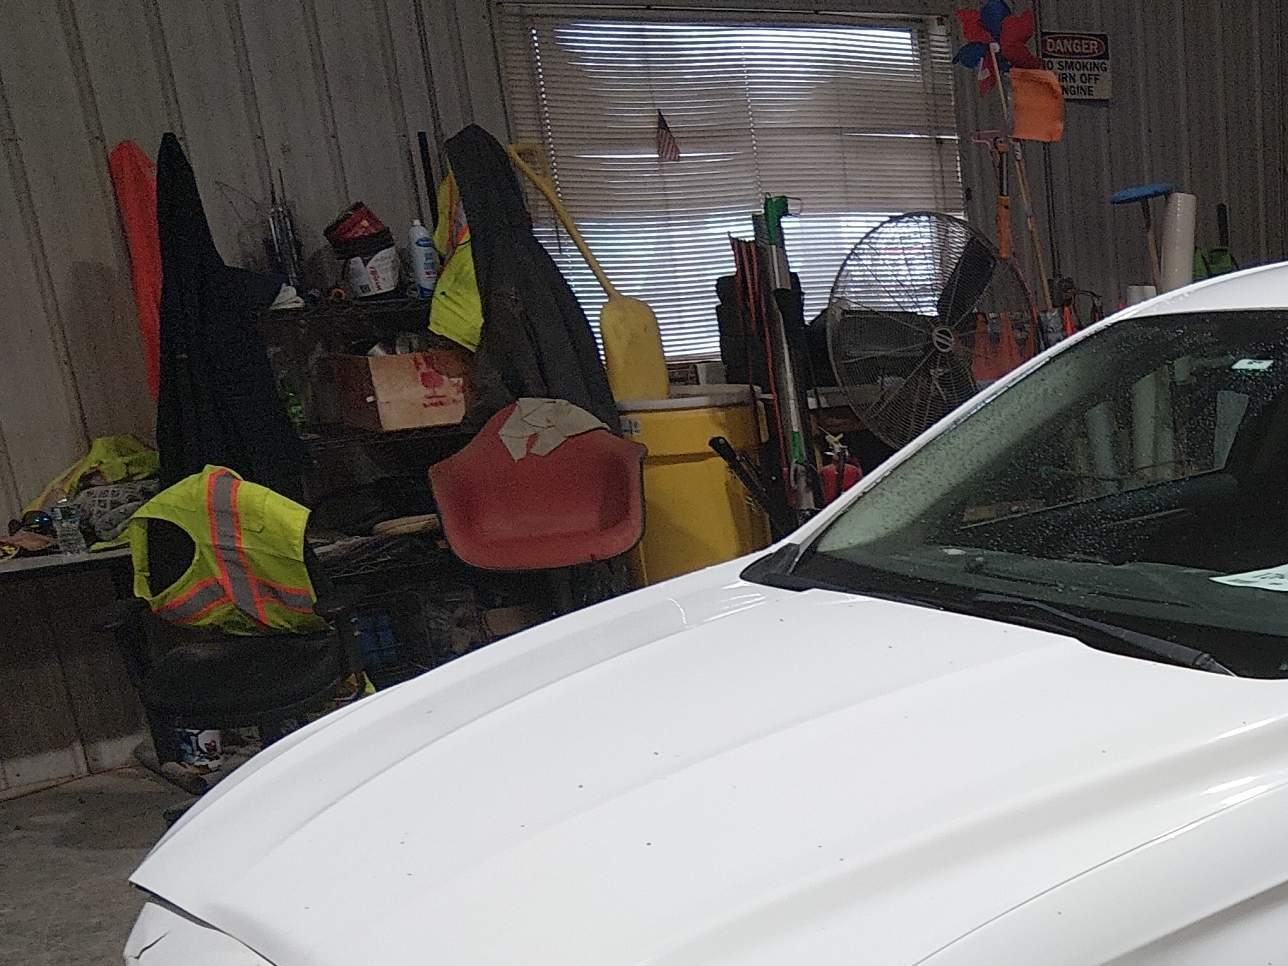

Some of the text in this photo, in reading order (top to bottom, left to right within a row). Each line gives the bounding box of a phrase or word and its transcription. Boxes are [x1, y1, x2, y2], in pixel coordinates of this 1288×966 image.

[1046, 38, 1098, 54] DANGER
[1057, 61, 1107, 73] SMOKING
[1058, 73, 1100, 85] RN OFF
[1062, 85, 1094, 97] NGINE
